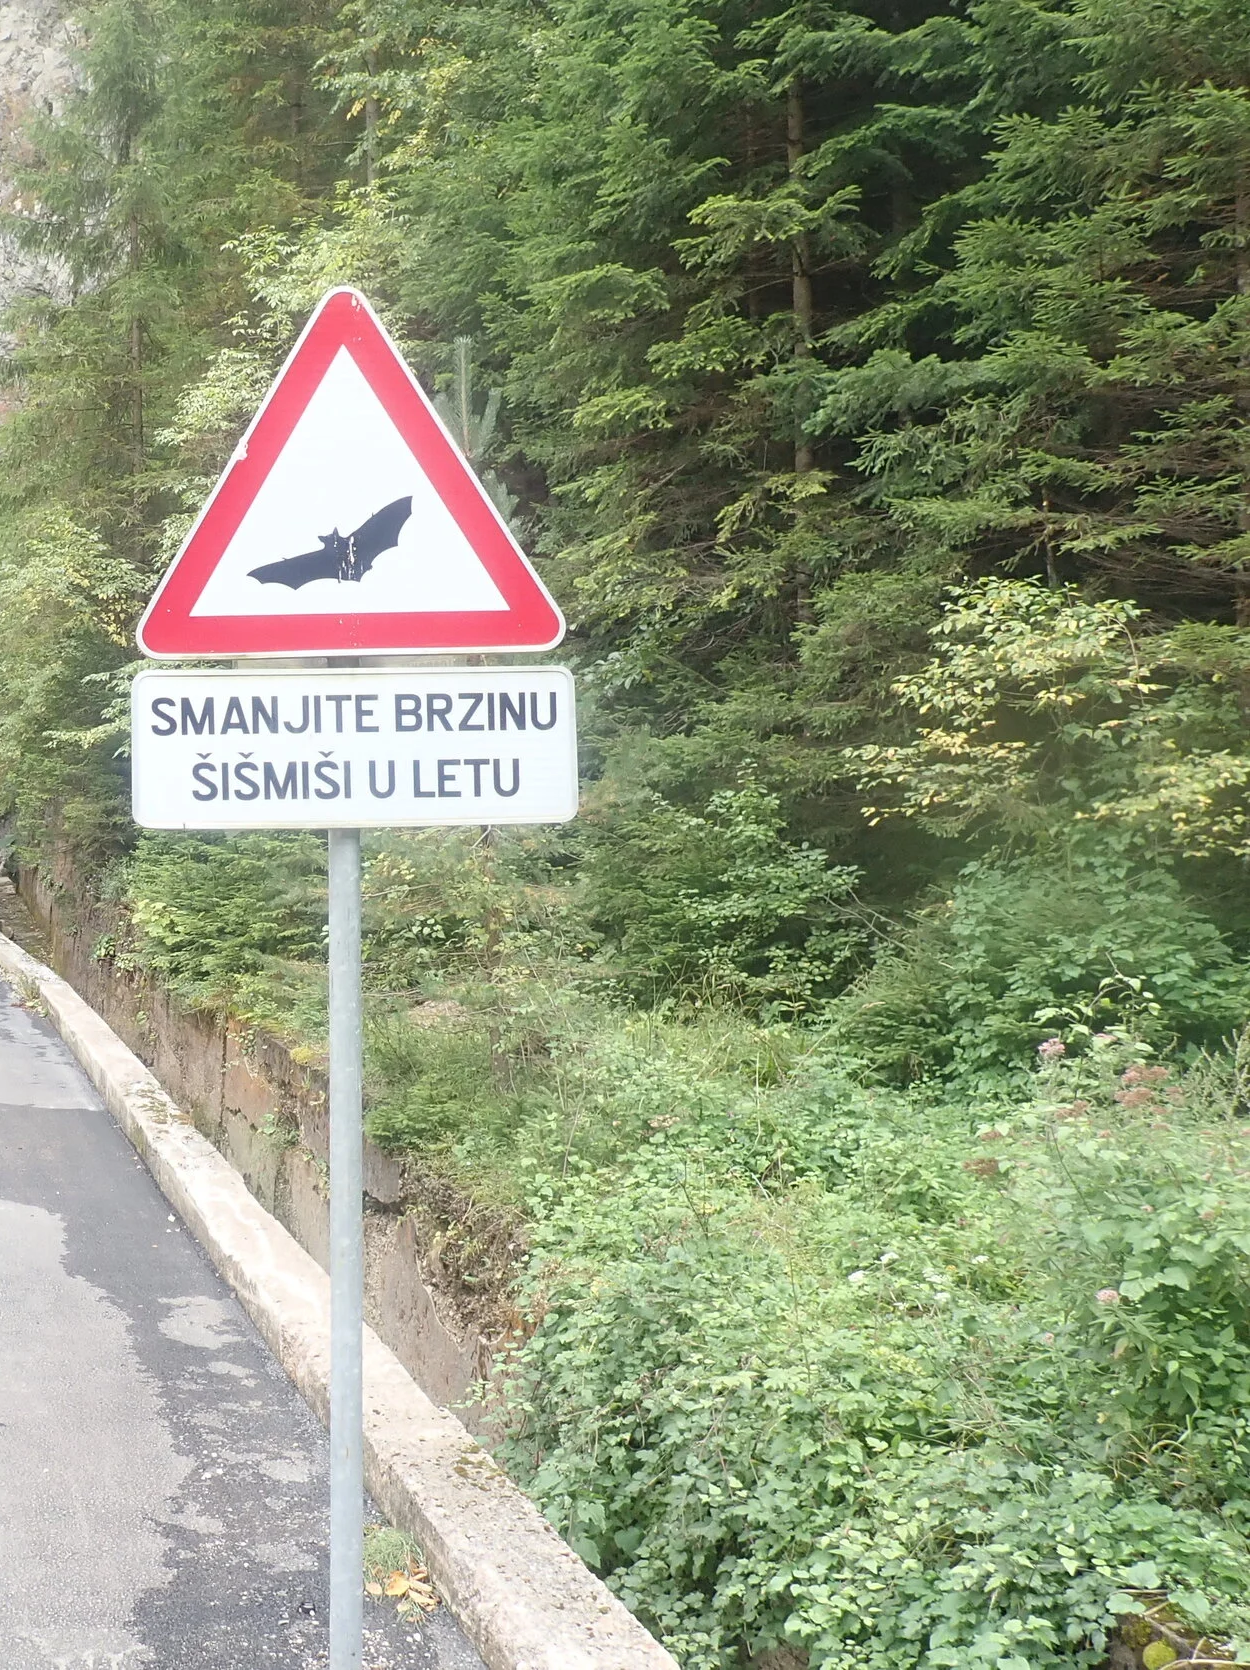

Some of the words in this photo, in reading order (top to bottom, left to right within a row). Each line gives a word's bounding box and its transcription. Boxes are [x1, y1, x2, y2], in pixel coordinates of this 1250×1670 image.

[151, 694, 379, 736] SMANJITE
[395, 691, 557, 732] BRZINU
[192, 751, 351, 801] ŠIŠMIŠI
[369, 760, 396, 799] U
[413, 758, 520, 798] LETU
